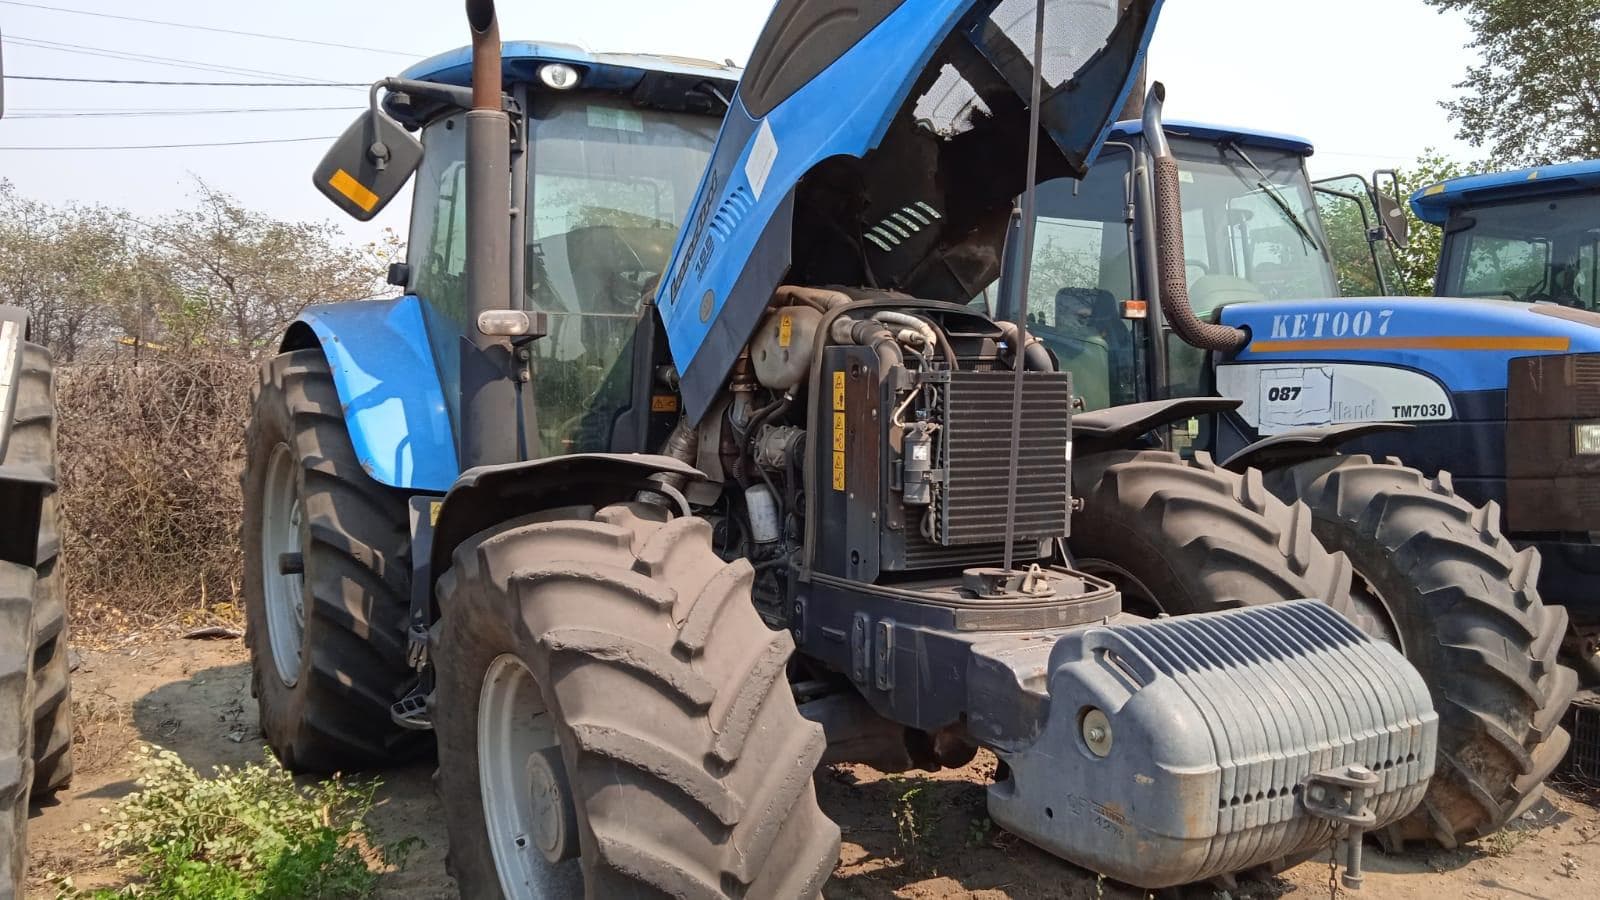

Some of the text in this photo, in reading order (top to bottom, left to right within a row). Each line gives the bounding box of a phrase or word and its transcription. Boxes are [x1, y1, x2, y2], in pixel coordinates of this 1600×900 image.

[1270, 309, 1394, 339] KET007
[1268, 386, 1302, 402] 087
[1392, 403, 1446, 418] TM7030
